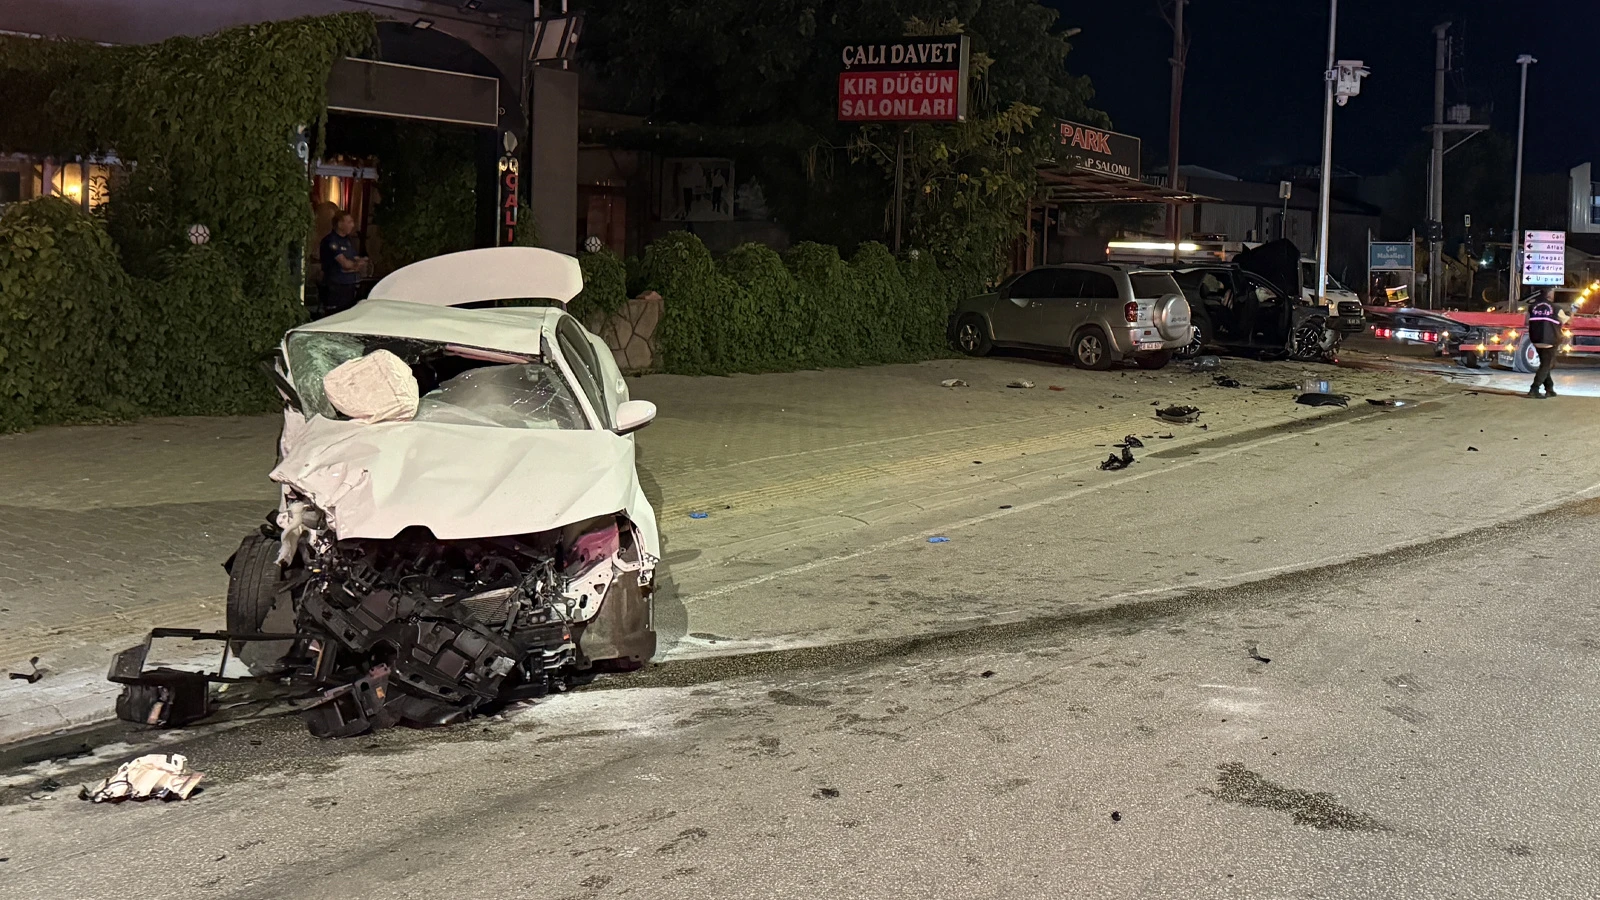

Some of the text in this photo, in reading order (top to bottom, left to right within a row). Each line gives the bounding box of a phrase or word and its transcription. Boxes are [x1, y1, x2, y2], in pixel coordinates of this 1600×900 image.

[842, 43, 957, 70] ÇALI DAVET
[843, 72, 954, 95] KIR DÜĞÜN
[841, 98, 953, 117] SALONLARI
[1060, 123, 1112, 155] PARK
[1095, 159, 1130, 176] SALONU
[505, 173, 519, 242] ÇALI
